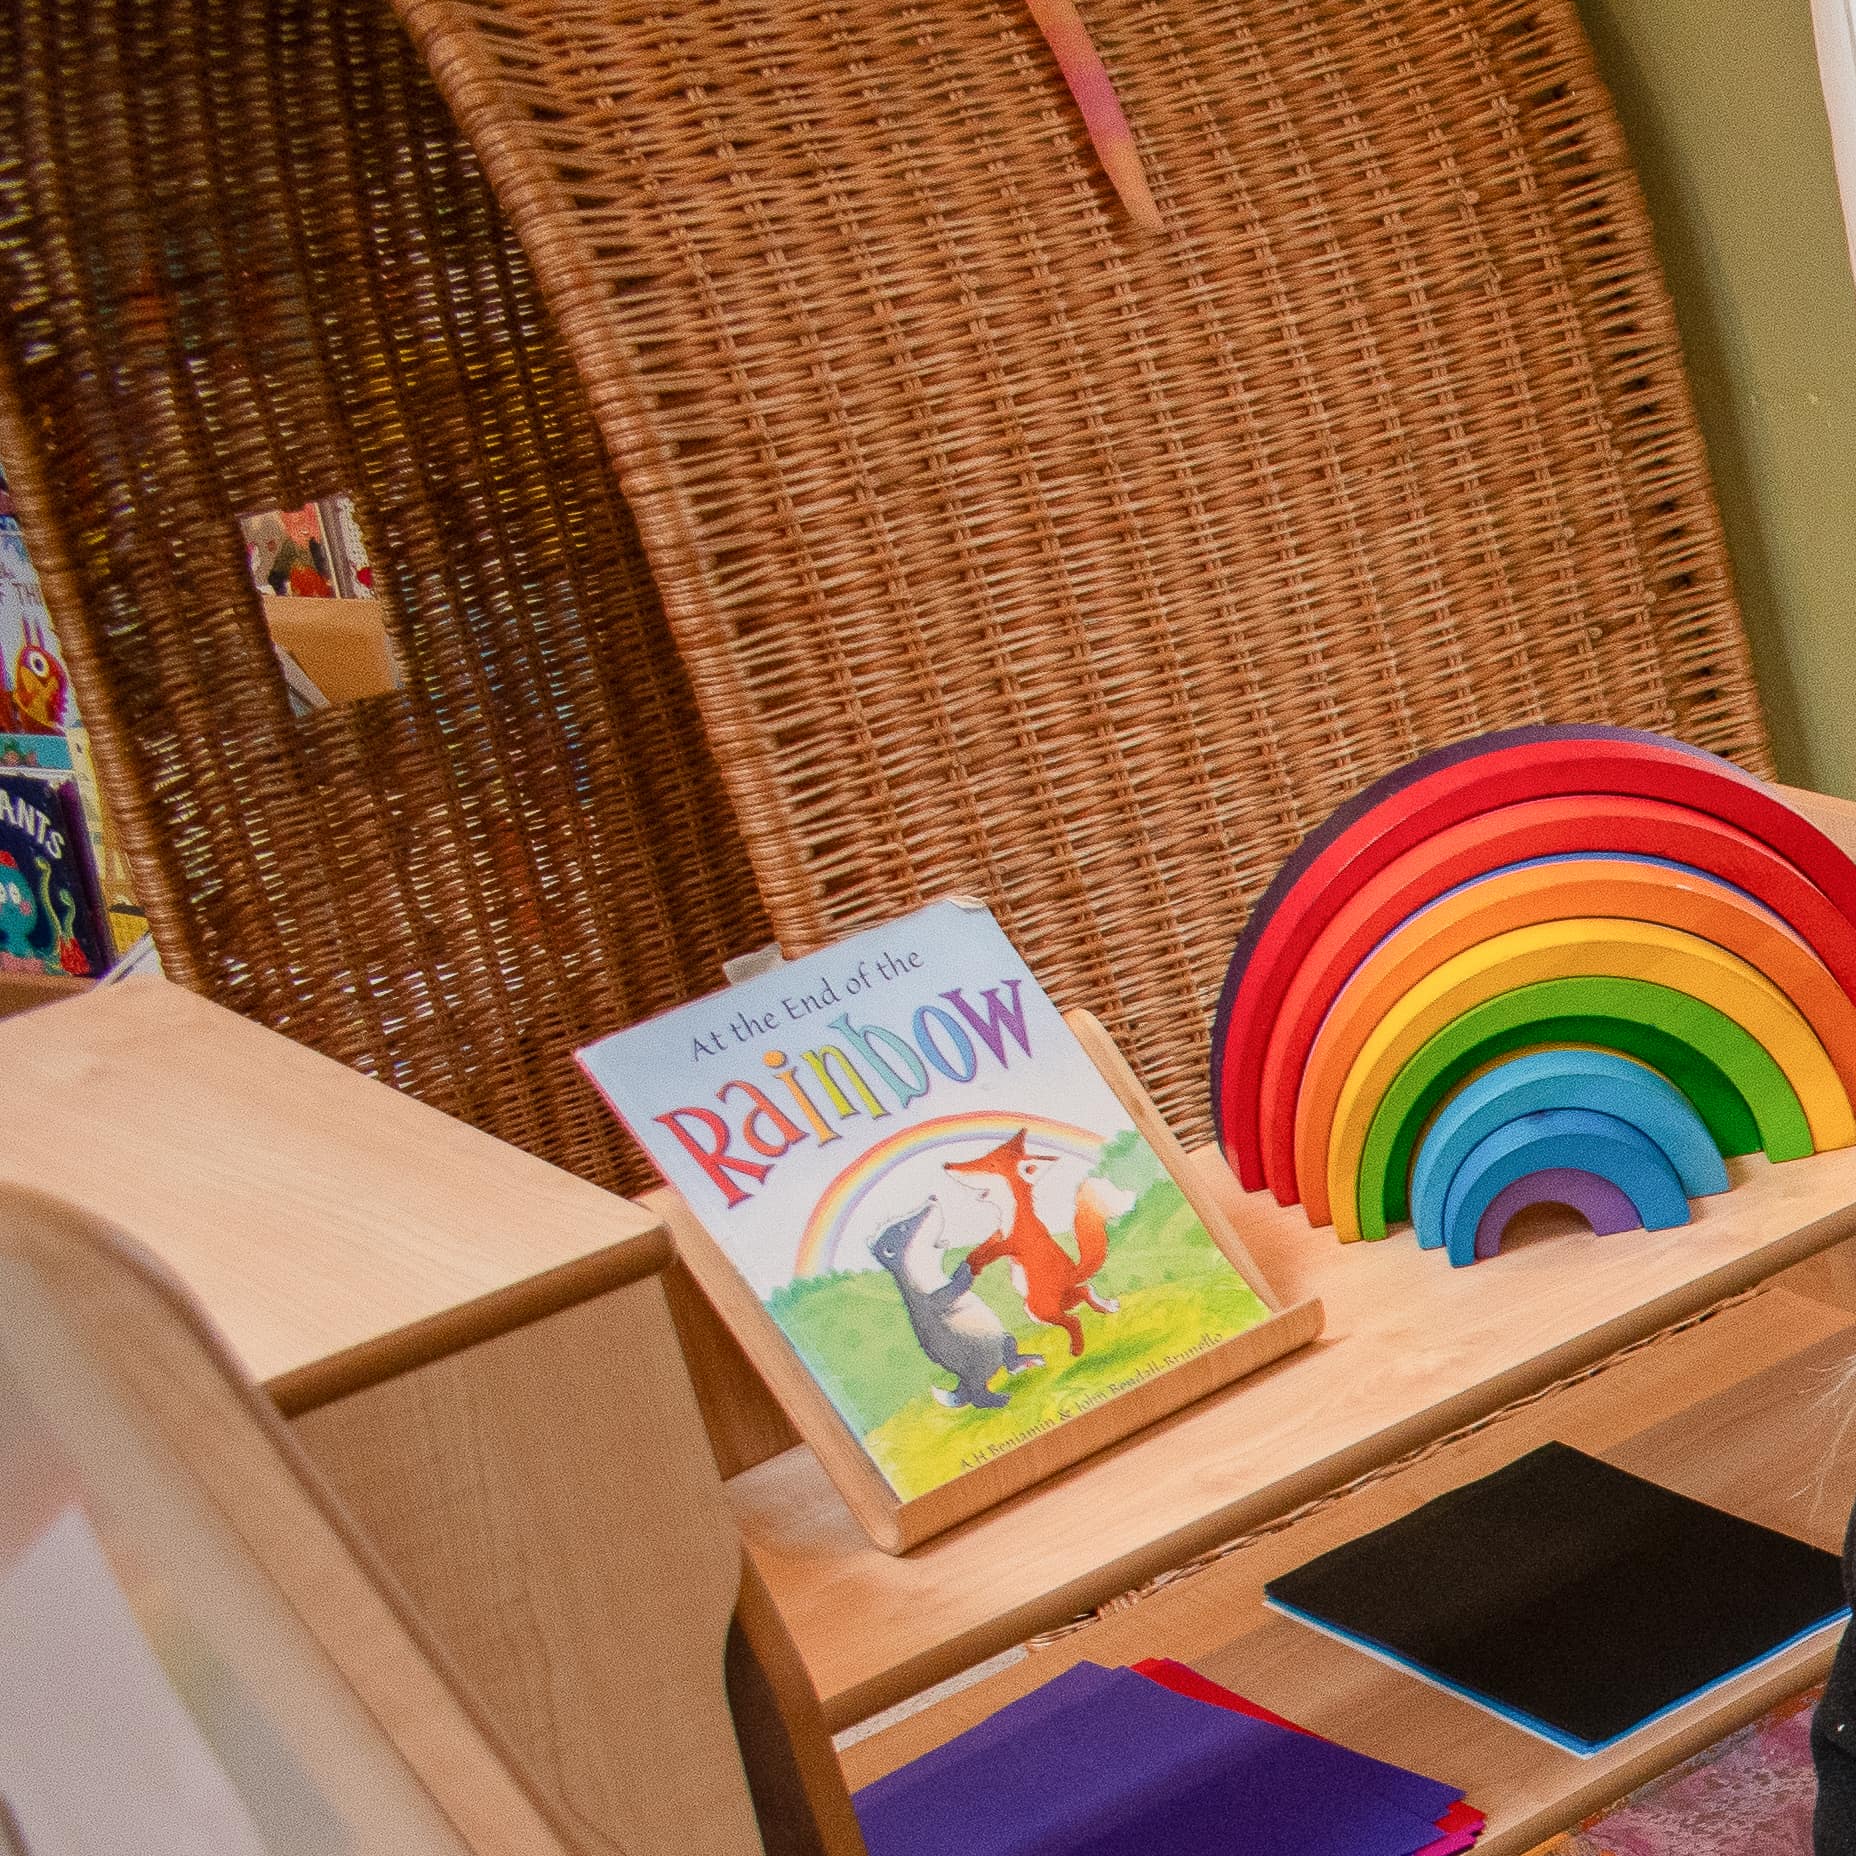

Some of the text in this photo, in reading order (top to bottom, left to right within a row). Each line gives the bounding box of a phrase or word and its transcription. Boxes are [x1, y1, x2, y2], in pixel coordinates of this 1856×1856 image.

[0, 788, 65, 860] ANTS
[692, 949, 925, 1062] At the End of the
[652, 979, 1033, 1210] Rainbow
